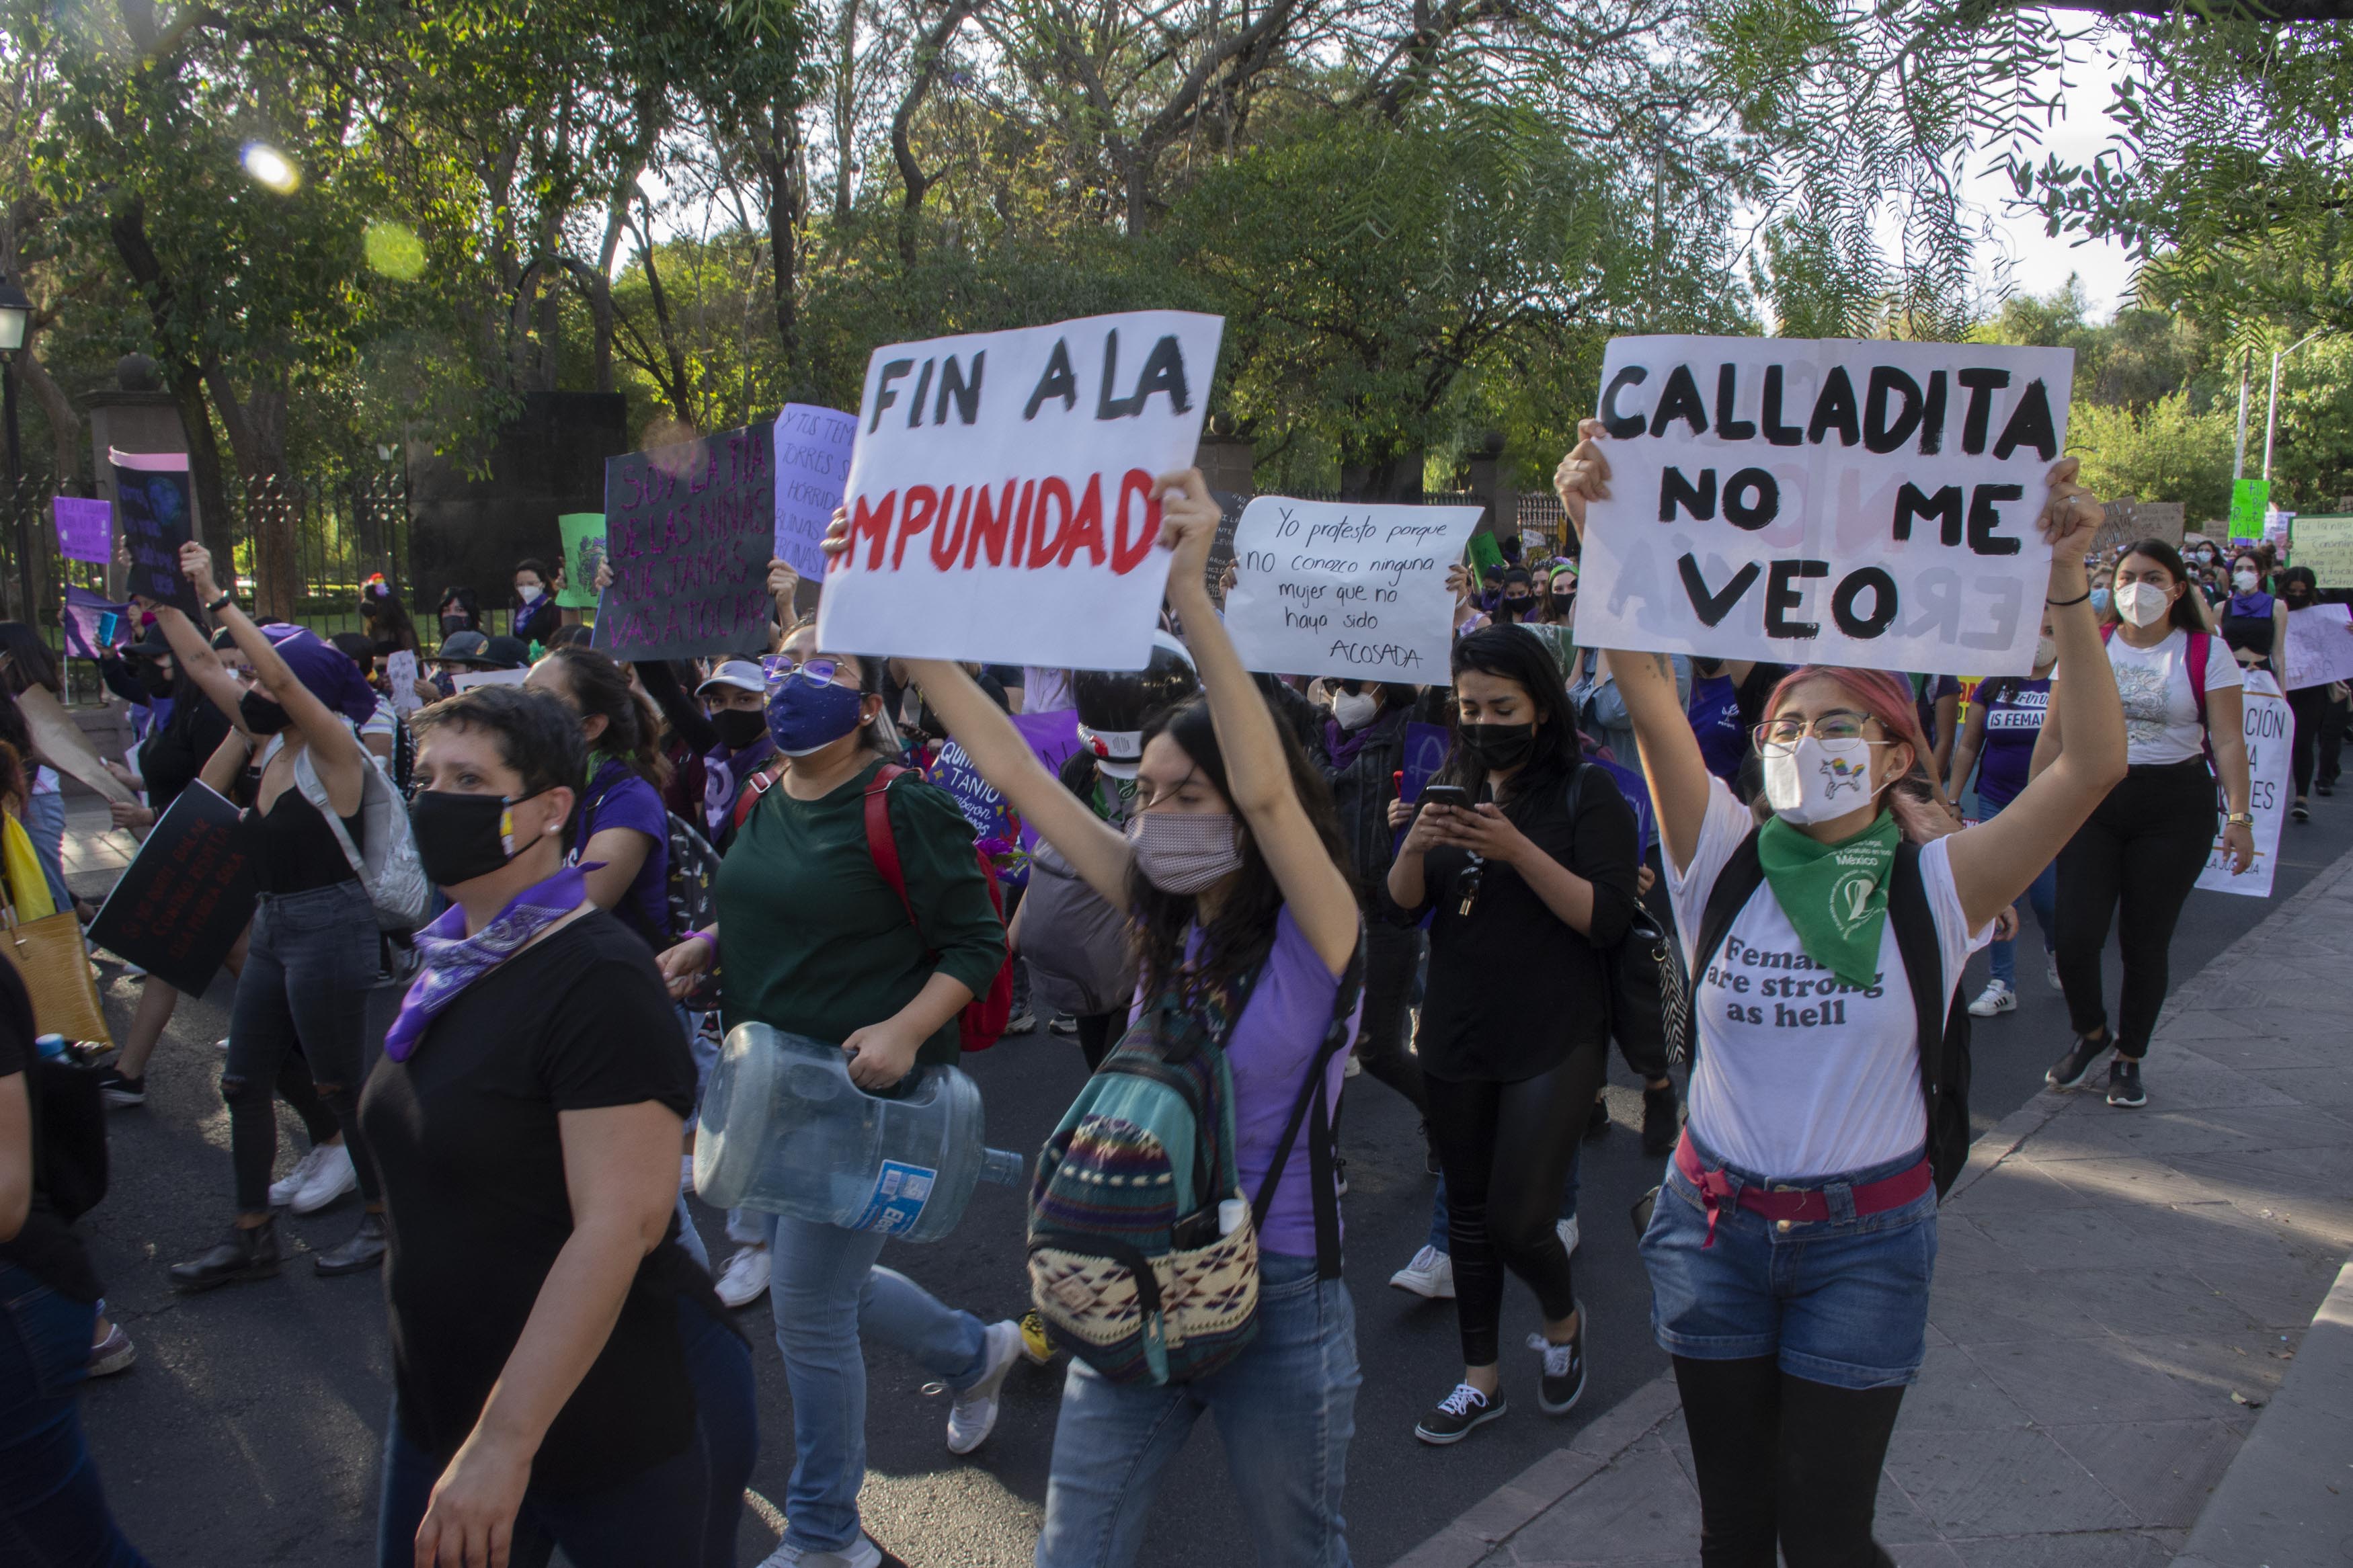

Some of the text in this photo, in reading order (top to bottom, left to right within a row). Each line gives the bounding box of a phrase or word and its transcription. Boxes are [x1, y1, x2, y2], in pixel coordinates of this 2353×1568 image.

[868, 327, 1193, 435] FIN A LA
[797, 413, 821, 436] TUS
[825, 417, 856, 448] TEM
[1601, 362, 2057, 463] CALLADITA
[783, 442, 834, 476] TORRES
[620, 456, 679, 511] SOY
[690, 445, 720, 494] LA
[1276, 507, 1447, 548] Yo protesto porque
[1659, 466, 2024, 556] NO ME
[610, 517, 645, 561] DE
[649, 503, 692, 555] LAS
[612, 559, 657, 606] QUE
[1247, 550, 1435, 587] no conozco ninguna
[1279, 583, 1397, 609] mujer que no
[1677, 552, 1899, 641] VEO
[608, 589, 767, 650] VAS A TOCAR
[1285, 606, 1378, 635] haya sido
[1329, 640, 1424, 669] ACOSADA
[2018, 693, 2049, 706] FUTU
[1991, 714, 2001, 727] IS
[2245, 702, 2285, 739] CIÓN
[1835, 854, 1878, 866] México
[1724, 934, 1827, 971] Fema
[1708, 966, 1751, 993] are
[1726, 999, 1846, 1027] as hell
